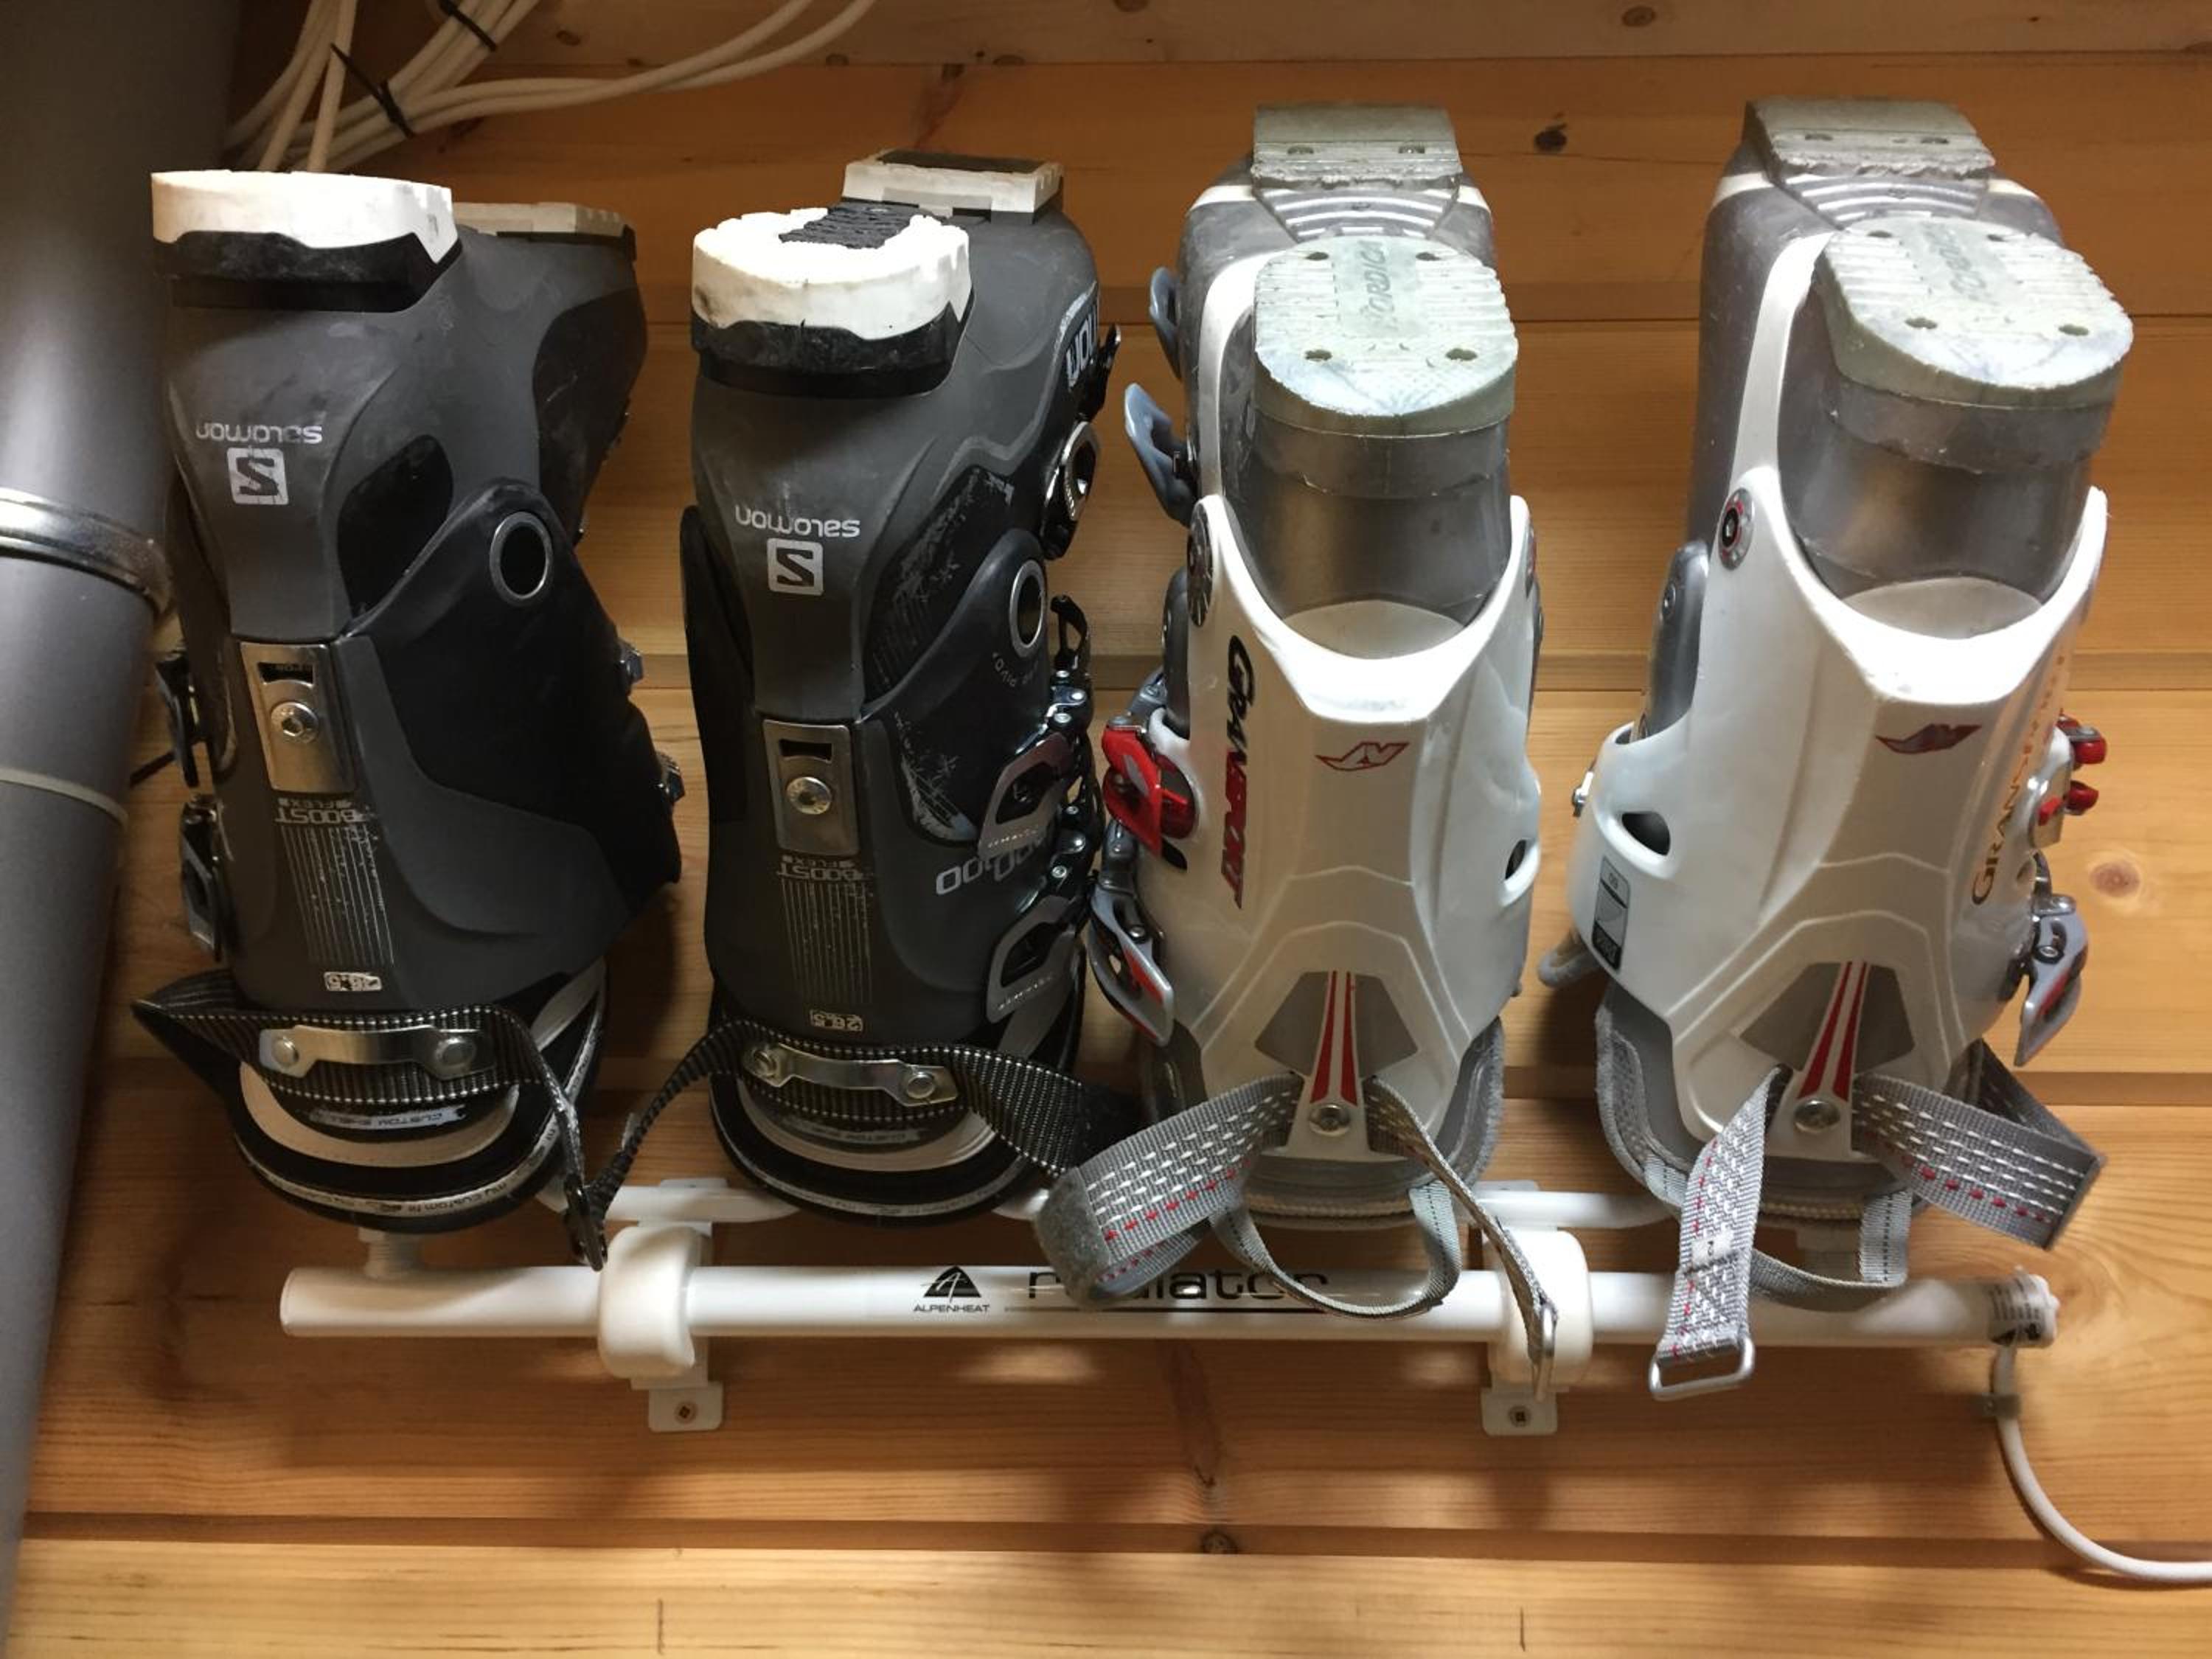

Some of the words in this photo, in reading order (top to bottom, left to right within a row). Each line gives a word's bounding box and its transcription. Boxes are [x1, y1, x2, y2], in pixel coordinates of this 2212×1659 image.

[735, 506, 860, 538] salomon
[275, 808, 359, 825] BOOST
[775, 863, 858, 880] BOOST
[1028, 1267, 1328, 1301] riator
[913, 1304, 990, 1313] ALPENHEAT
